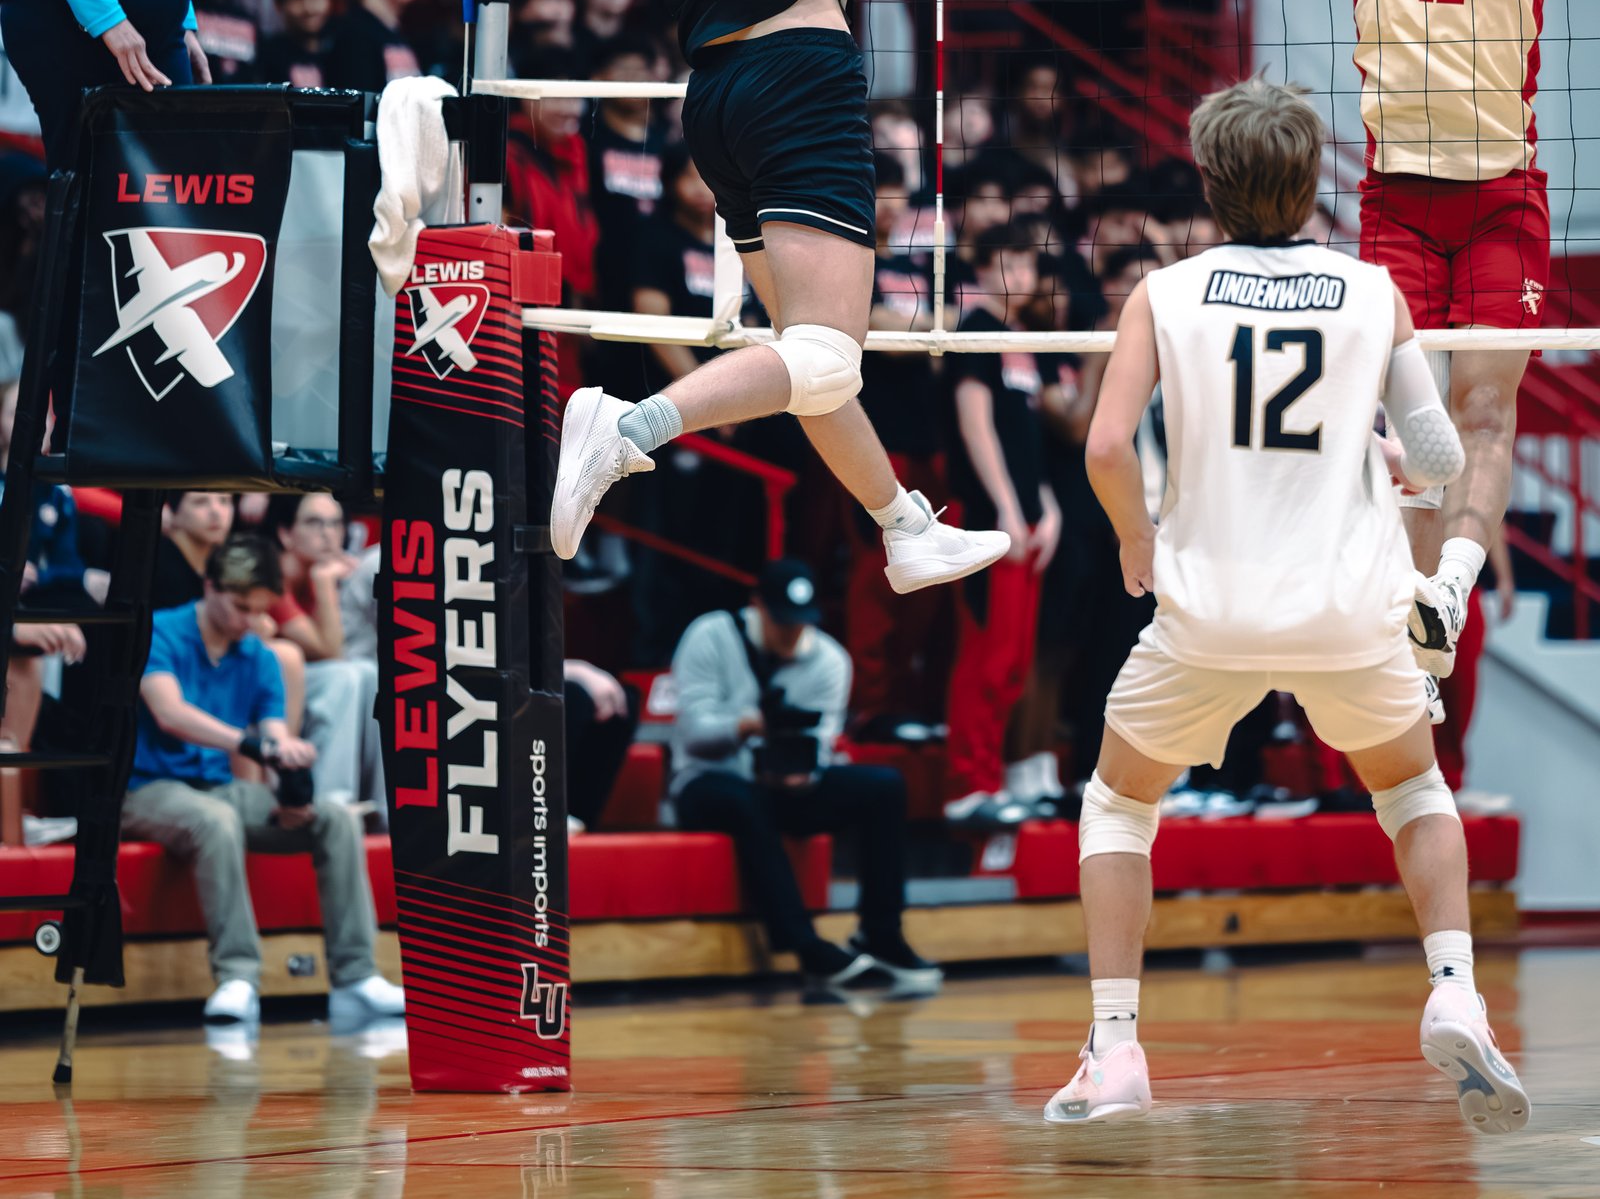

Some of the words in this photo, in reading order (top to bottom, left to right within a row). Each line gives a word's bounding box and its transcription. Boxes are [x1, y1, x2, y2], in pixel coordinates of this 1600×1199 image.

[117, 172, 255, 204] LEWIS
[411, 260, 485, 284] LEWIS
[1205, 271, 1345, 311] LINDENWOOD
[1226, 322, 1325, 455] 12
[391, 518, 438, 809] LEWIS
[441, 468, 499, 856] FLYERS
[530, 739, 548, 831] sports
[531, 836, 549, 948] imports
